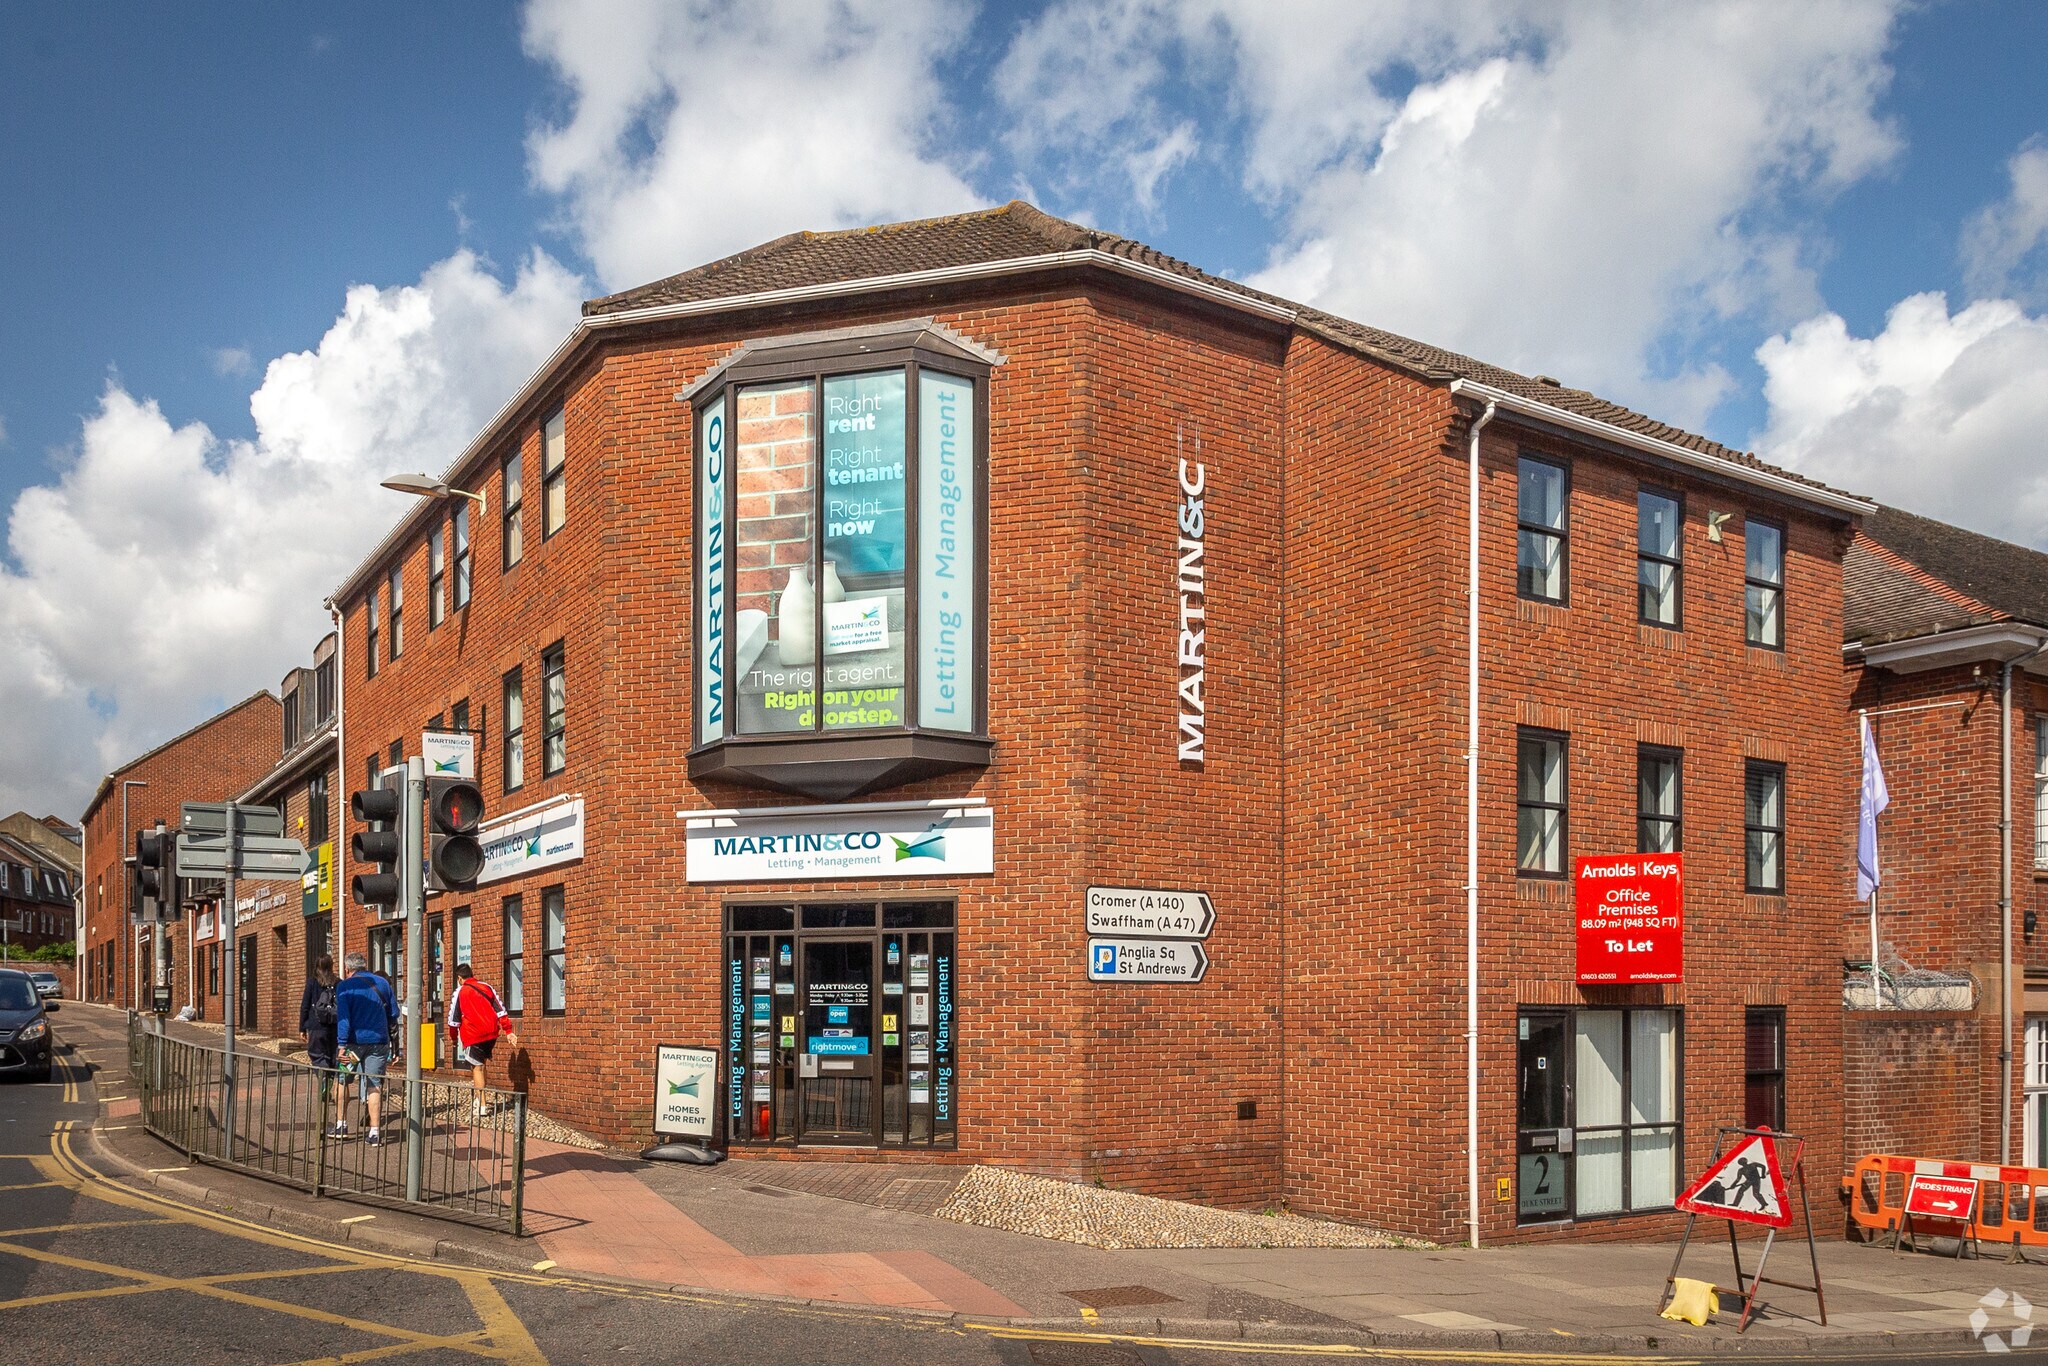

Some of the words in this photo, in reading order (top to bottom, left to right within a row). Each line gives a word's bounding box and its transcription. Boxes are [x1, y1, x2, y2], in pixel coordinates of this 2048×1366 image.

[830, 393, 882, 417] Right
[829, 412, 876, 434] rent
[830, 445, 882, 468] Right
[828, 461, 903, 486] tenant
[935, 391, 961, 579] Management
[830, 497, 882, 520] Right
[828, 519, 876, 538] now
[708, 415, 723, 726] MARTIN&CO
[831, 619, 880, 632] MARTIN&CO
[935, 610, 961, 714] Letting
[750, 670, 785, 687] The
[789, 667, 833, 687] rigt
[838, 663, 897, 685] agent.
[823, 690, 848, 705] on
[849, 688, 899, 707] your
[427, 737, 471, 746] MARTIN&CO
[483, 835, 524, 861] ARTIN&CO
[545, 841, 574, 856] martinco.com
[713, 830, 882, 856] MARTIN&CO
[767, 857, 804, 870] Letting
[814, 854, 882, 868] Management
[1581, 862, 1637, 879] Arnolds
[1643, 861, 1678, 879] Keys
[1091, 893, 1136, 908] Cromer
[1140, 896, 1154, 911] (A
[1158, 897, 1185, 913] 140)
[1606, 888, 1651, 902] Office
[1598, 903, 1659, 916] Premises
[1091, 913, 1154, 929] Swaffham
[1157, 916, 1171, 932] (A
[1174, 918, 1196, 933] 47)
[1581, 919, 1607, 929] 88.09
[1623, 918, 1644, 930] (948
[1645, 918, 1660, 929] SQ
[1662, 917, 1677, 929] FT)
[1119, 945, 1156, 960] Anglia
[1160, 946, 1176, 961] Sq
[1604, 939, 1624, 953] To
[1627, 939, 1654, 952] Let
[1119, 962, 1133, 974] St
[1137, 962, 1187, 974] Andrews
[1630, 972, 1677, 980] arnoldskeys.com
[730, 959, 745, 1051] Management
[829, 1009, 847, 1018] open
[936, 956, 952, 1052] Management
[811, 1042, 858, 1053] rightmove
[662, 1053, 713, 1063] MARTIN&CO
[730, 1065, 745, 1117] Letting
[936, 1067, 952, 1121] Letting
[662, 1113, 681, 1123] FOR
[682, 1115, 706, 1125] RENT
[668, 1104, 700, 1115] HOMES
[1533, 1155, 1550, 1195] 2
[1914, 1181, 1973, 1195] PEDESTRIANS
[1539, 1196, 1563, 1206] STREET
